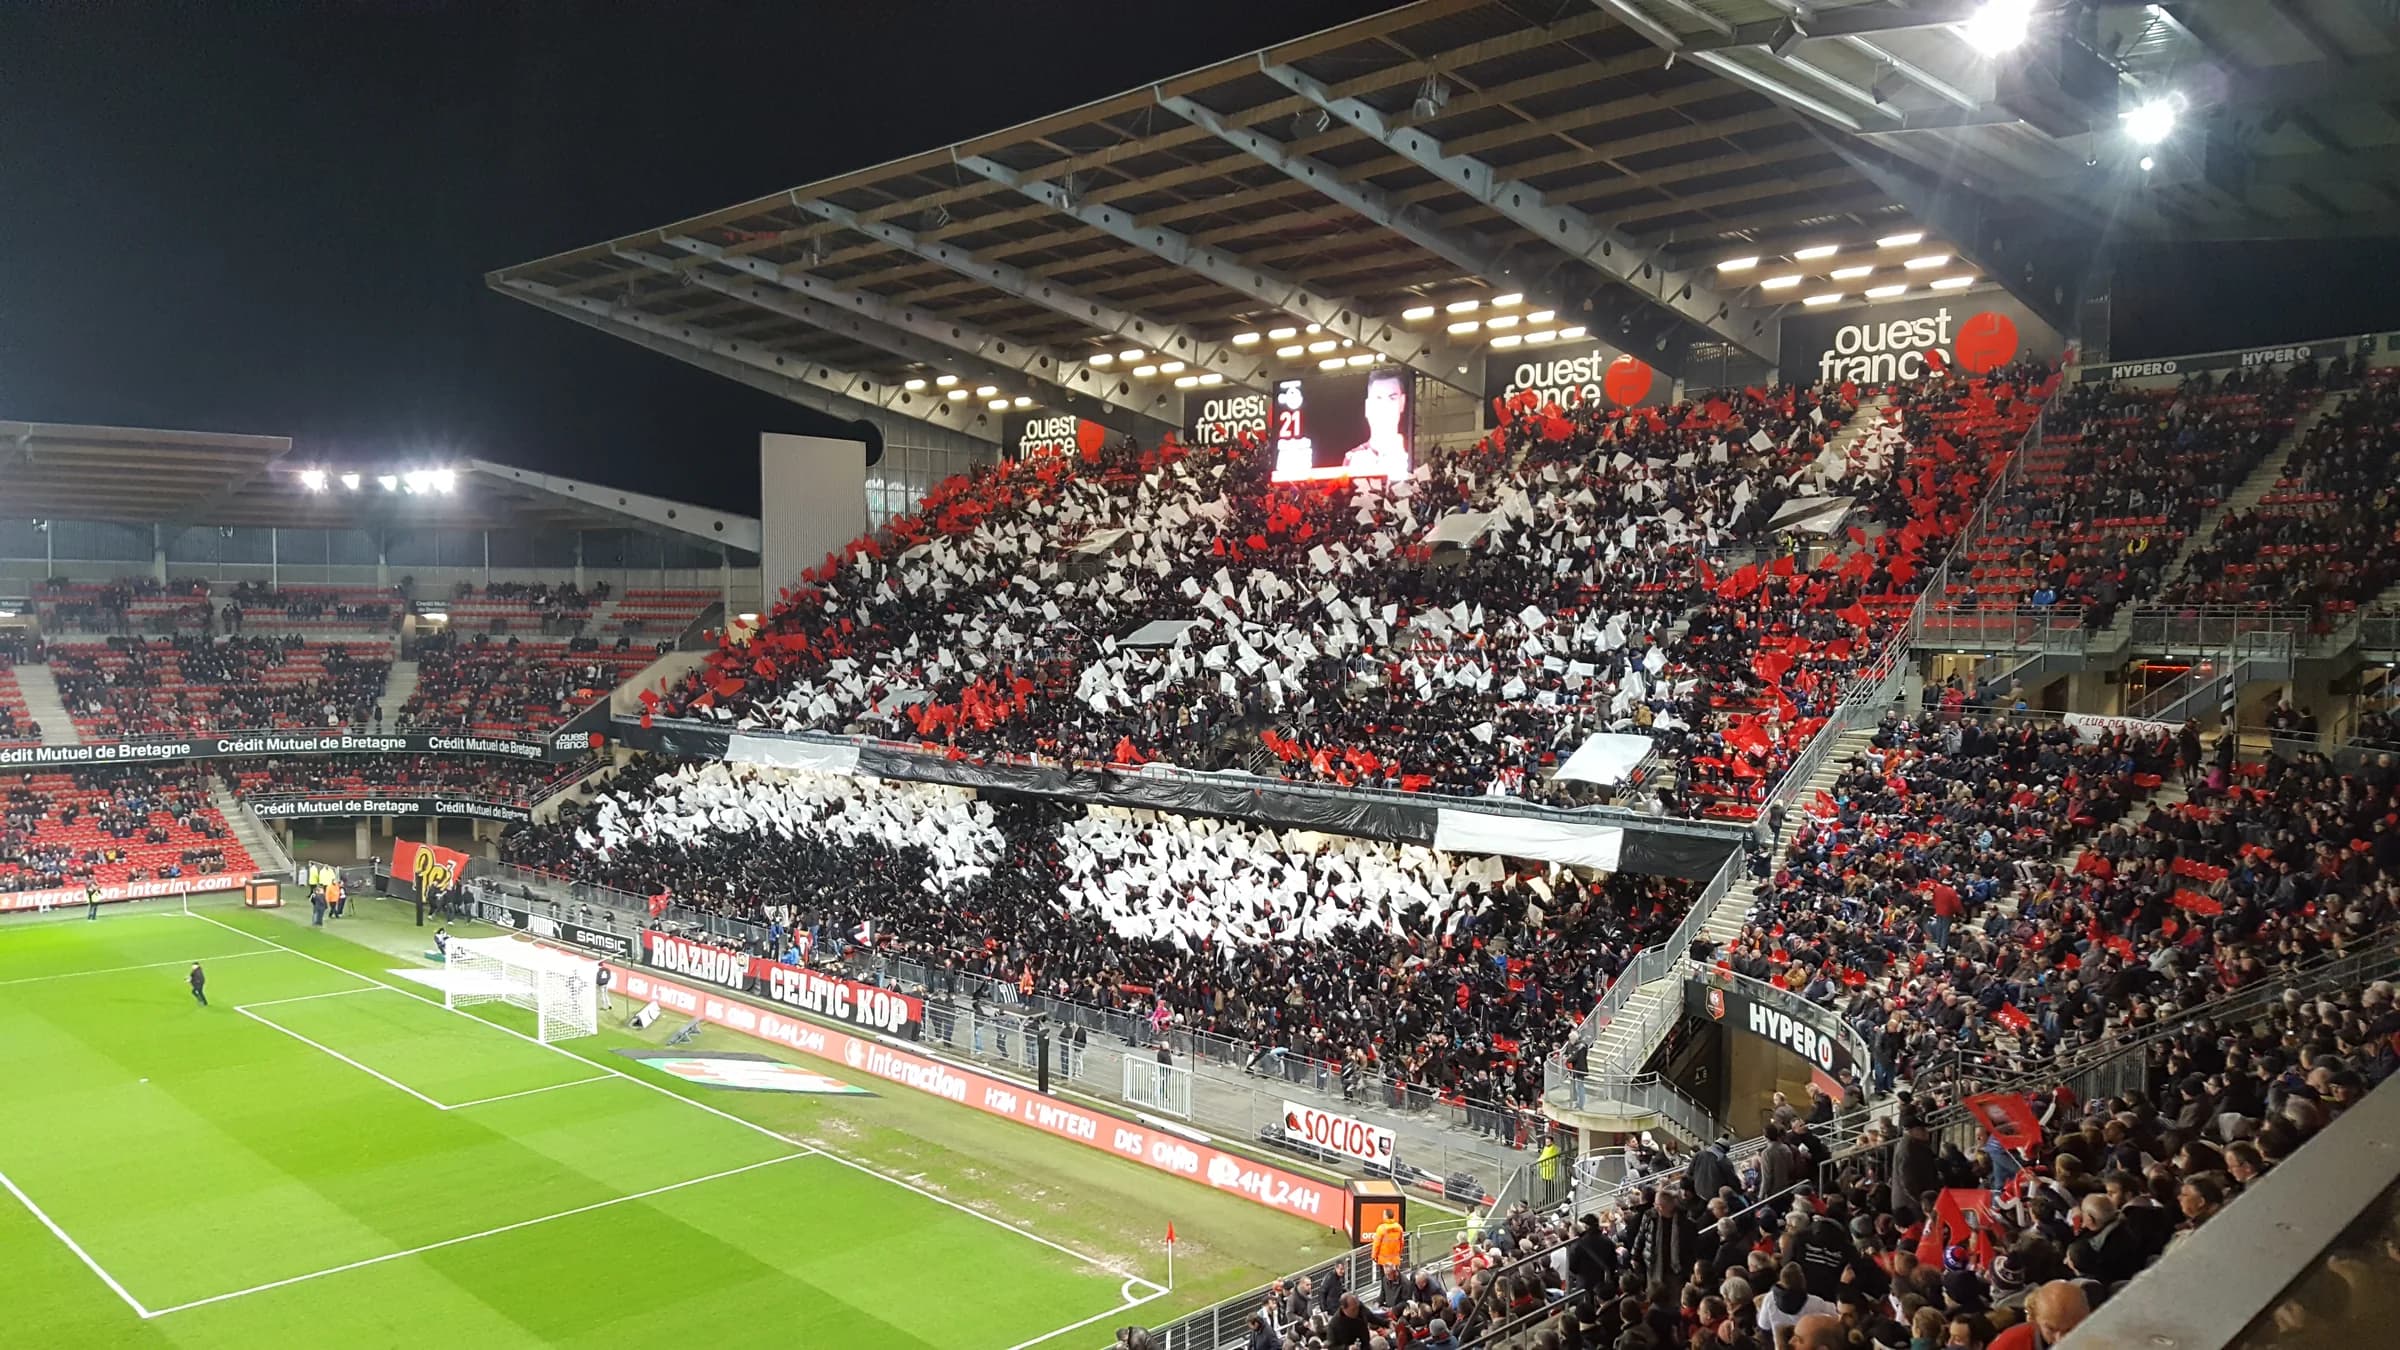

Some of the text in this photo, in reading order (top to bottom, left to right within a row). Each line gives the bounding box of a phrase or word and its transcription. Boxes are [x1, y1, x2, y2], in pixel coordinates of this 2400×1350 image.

[1835, 307, 1951, 354] ouest
[2242, 349, 2294, 366] HYPER
[1515, 350, 1602, 388] ouest
[2112, 362, 2161, 378] HYPER
[1204, 394, 1266, 421] ouest
[1026, 415, 1076, 439] ouest
[1279, 410, 1300, 438] 21
[217, 736, 407, 752] Crédit Mutuel de Bretagne
[429, 737, 542, 758] Crédit Mutuel de Bretagne
[556, 739, 589, 749] france
[560, 731, 588, 742] ouest
[0, 743, 191, 763] édit Mutuel de Bretagne
[254, 799, 419, 815] Crédit Mutuel de Bretagne
[436, 801, 465, 813] Crédit
[466, 803, 492, 817] Mutuel
[493, 804, 501, 817] de
[576, 930, 626, 951] SAMSIC
[652, 935, 749, 991] ROAZHON
[770, 967, 908, 1033] CELTIC KOP
[1750, 1003, 1816, 1061] HYPER
[867, 1045, 967, 1103] Interaction
[1305, 1110, 1375, 1158] SOCIOS
